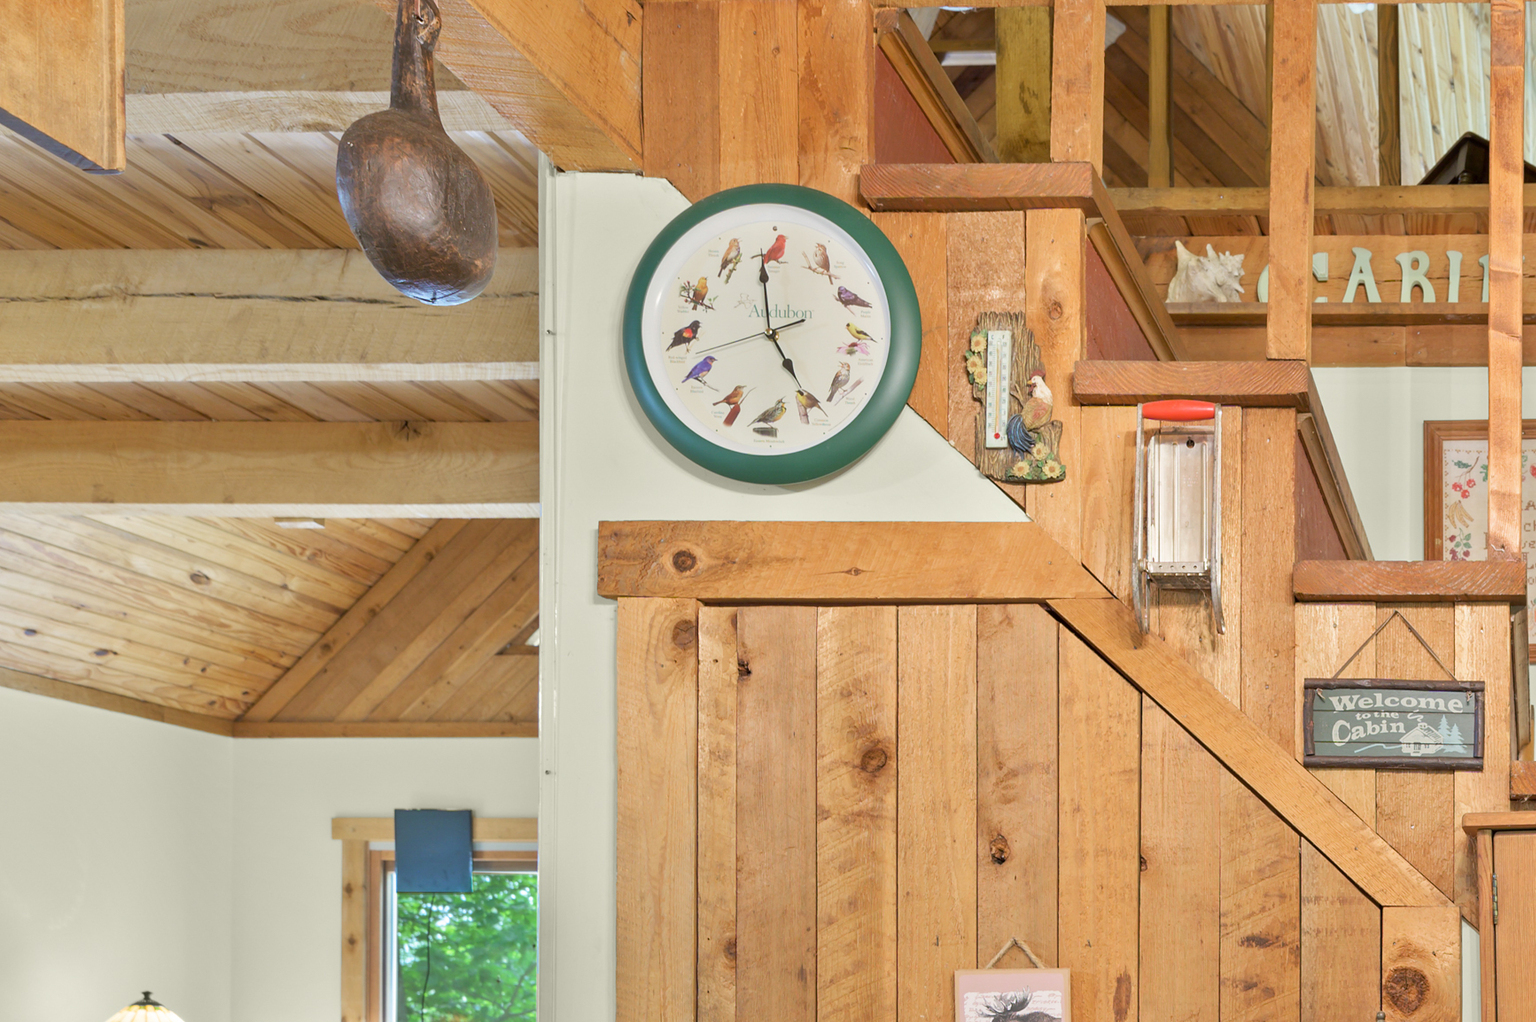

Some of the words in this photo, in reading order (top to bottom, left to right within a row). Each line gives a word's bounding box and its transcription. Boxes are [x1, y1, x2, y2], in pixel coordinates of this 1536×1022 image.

[748, 303, 813, 319] Audubon
[1328, 692, 1464, 714] Welcome
[1355, 712, 1372, 721] to
[1373, 709, 1400, 719] the
[1331, 719, 1406, 747] Cabin
